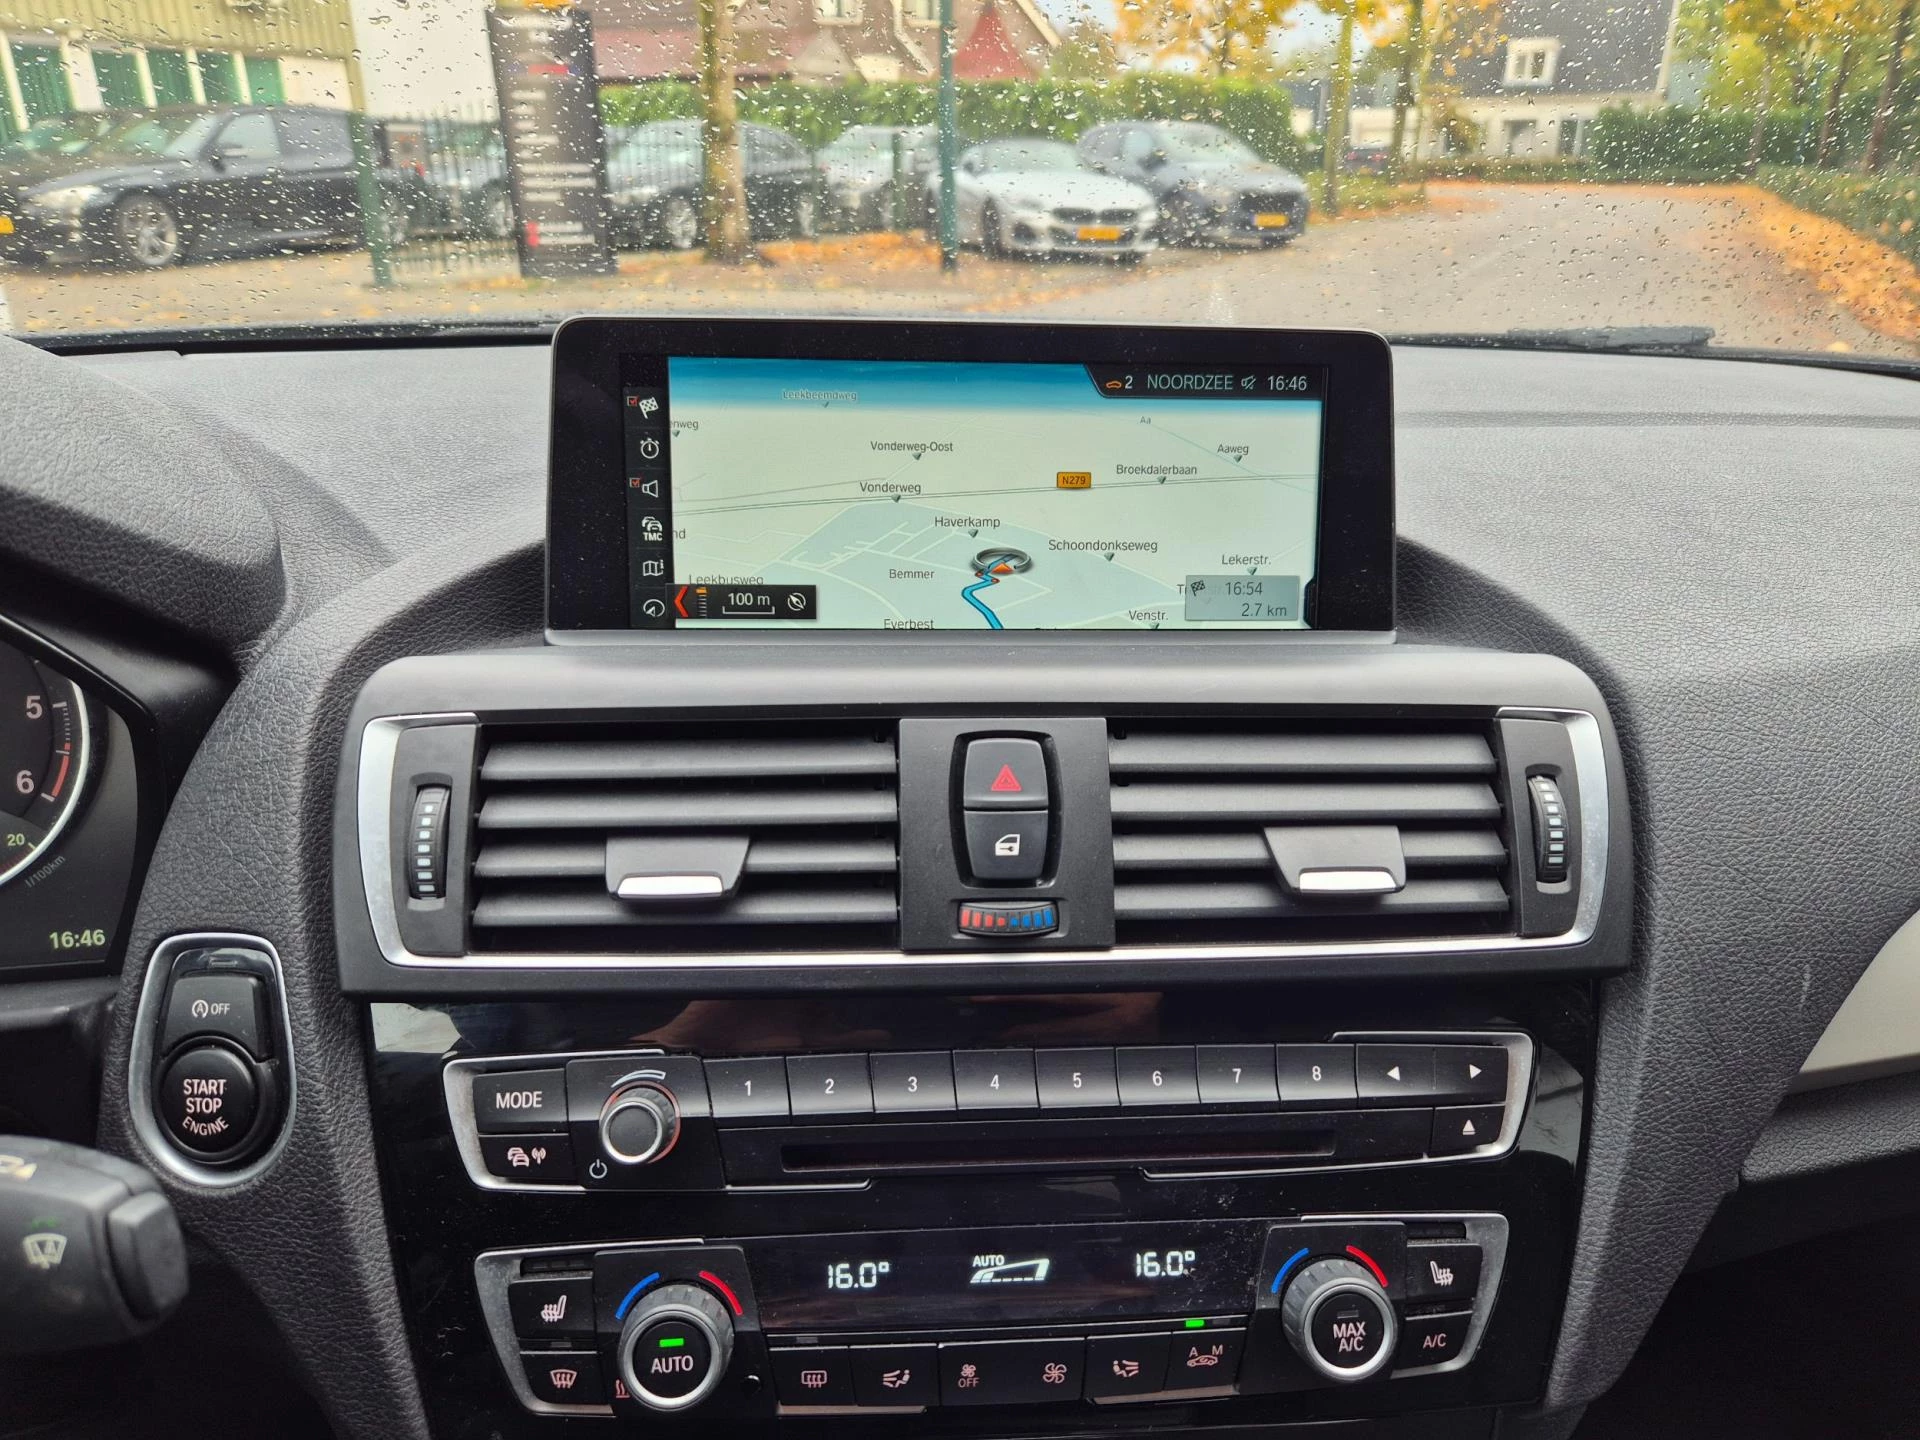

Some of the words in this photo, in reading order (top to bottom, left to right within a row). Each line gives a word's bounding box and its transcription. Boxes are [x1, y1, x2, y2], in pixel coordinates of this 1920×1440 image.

[1124, 375, 1133, 390] 2
[1147, 374, 1233, 390] NOORDZEE
[1267, 376, 1307, 391] 16:46
[870, 440, 953, 454] Vonderweg-Oost
[1217, 443, 1249, 456] Aaweg
[1116, 464, 1197, 476] Broekdalerbaan
[1062, 475, 1086, 486] N279
[860, 482, 921, 496] Vonderweg
[934, 516, 1000, 530] Haverkamp
[643, 532, 663, 541] TMC
[1048, 538, 1158, 553] Schoondonkseweg
[1221, 554, 1272, 566] Lekerstr.
[888, 568, 935, 580] Bemmer
[1225, 581, 1263, 597] 16:54
[728, 592, 753, 606] 100
[757, 595, 770, 606] m
[1129, 609, 1169, 621] Venstr.
[1241, 602, 1263, 618] 2.7
[1267, 602, 1288, 617] km
[883, 619, 935, 630] Everbest
[26, 695, 43, 719] 5
[16, 770, 35, 794] 6
[7, 833, 25, 847] 20
[50, 929, 106, 949] 16:46
[211, 1003, 230, 1015] OFF
[1072, 1072, 1082, 1088] 5
[1152, 1071, 1162, 1086] 6
[1232, 1069, 1242, 1084] 7
[1312, 1066, 1322, 1081] 8
[183, 1079, 227, 1095] START
[744, 1080, 752, 1096] 1
[825, 1079, 835, 1094] 2
[908, 1077, 918, 1093] 3
[989, 1074, 1000, 1090] 4
[186, 1097, 222, 1114] STOP
[495, 1092, 543, 1109] MODE
[182, 1116, 229, 1136] ENGINE
[973, 1254, 1005, 1267] AUTO
[1333, 1322, 1366, 1338] MAX
[1338, 1336, 1364, 1352] A/C
[1423, 1333, 1447, 1349] A/C
[651, 1356, 694, 1374] AUTO
[958, 1377, 979, 1388] OFF
